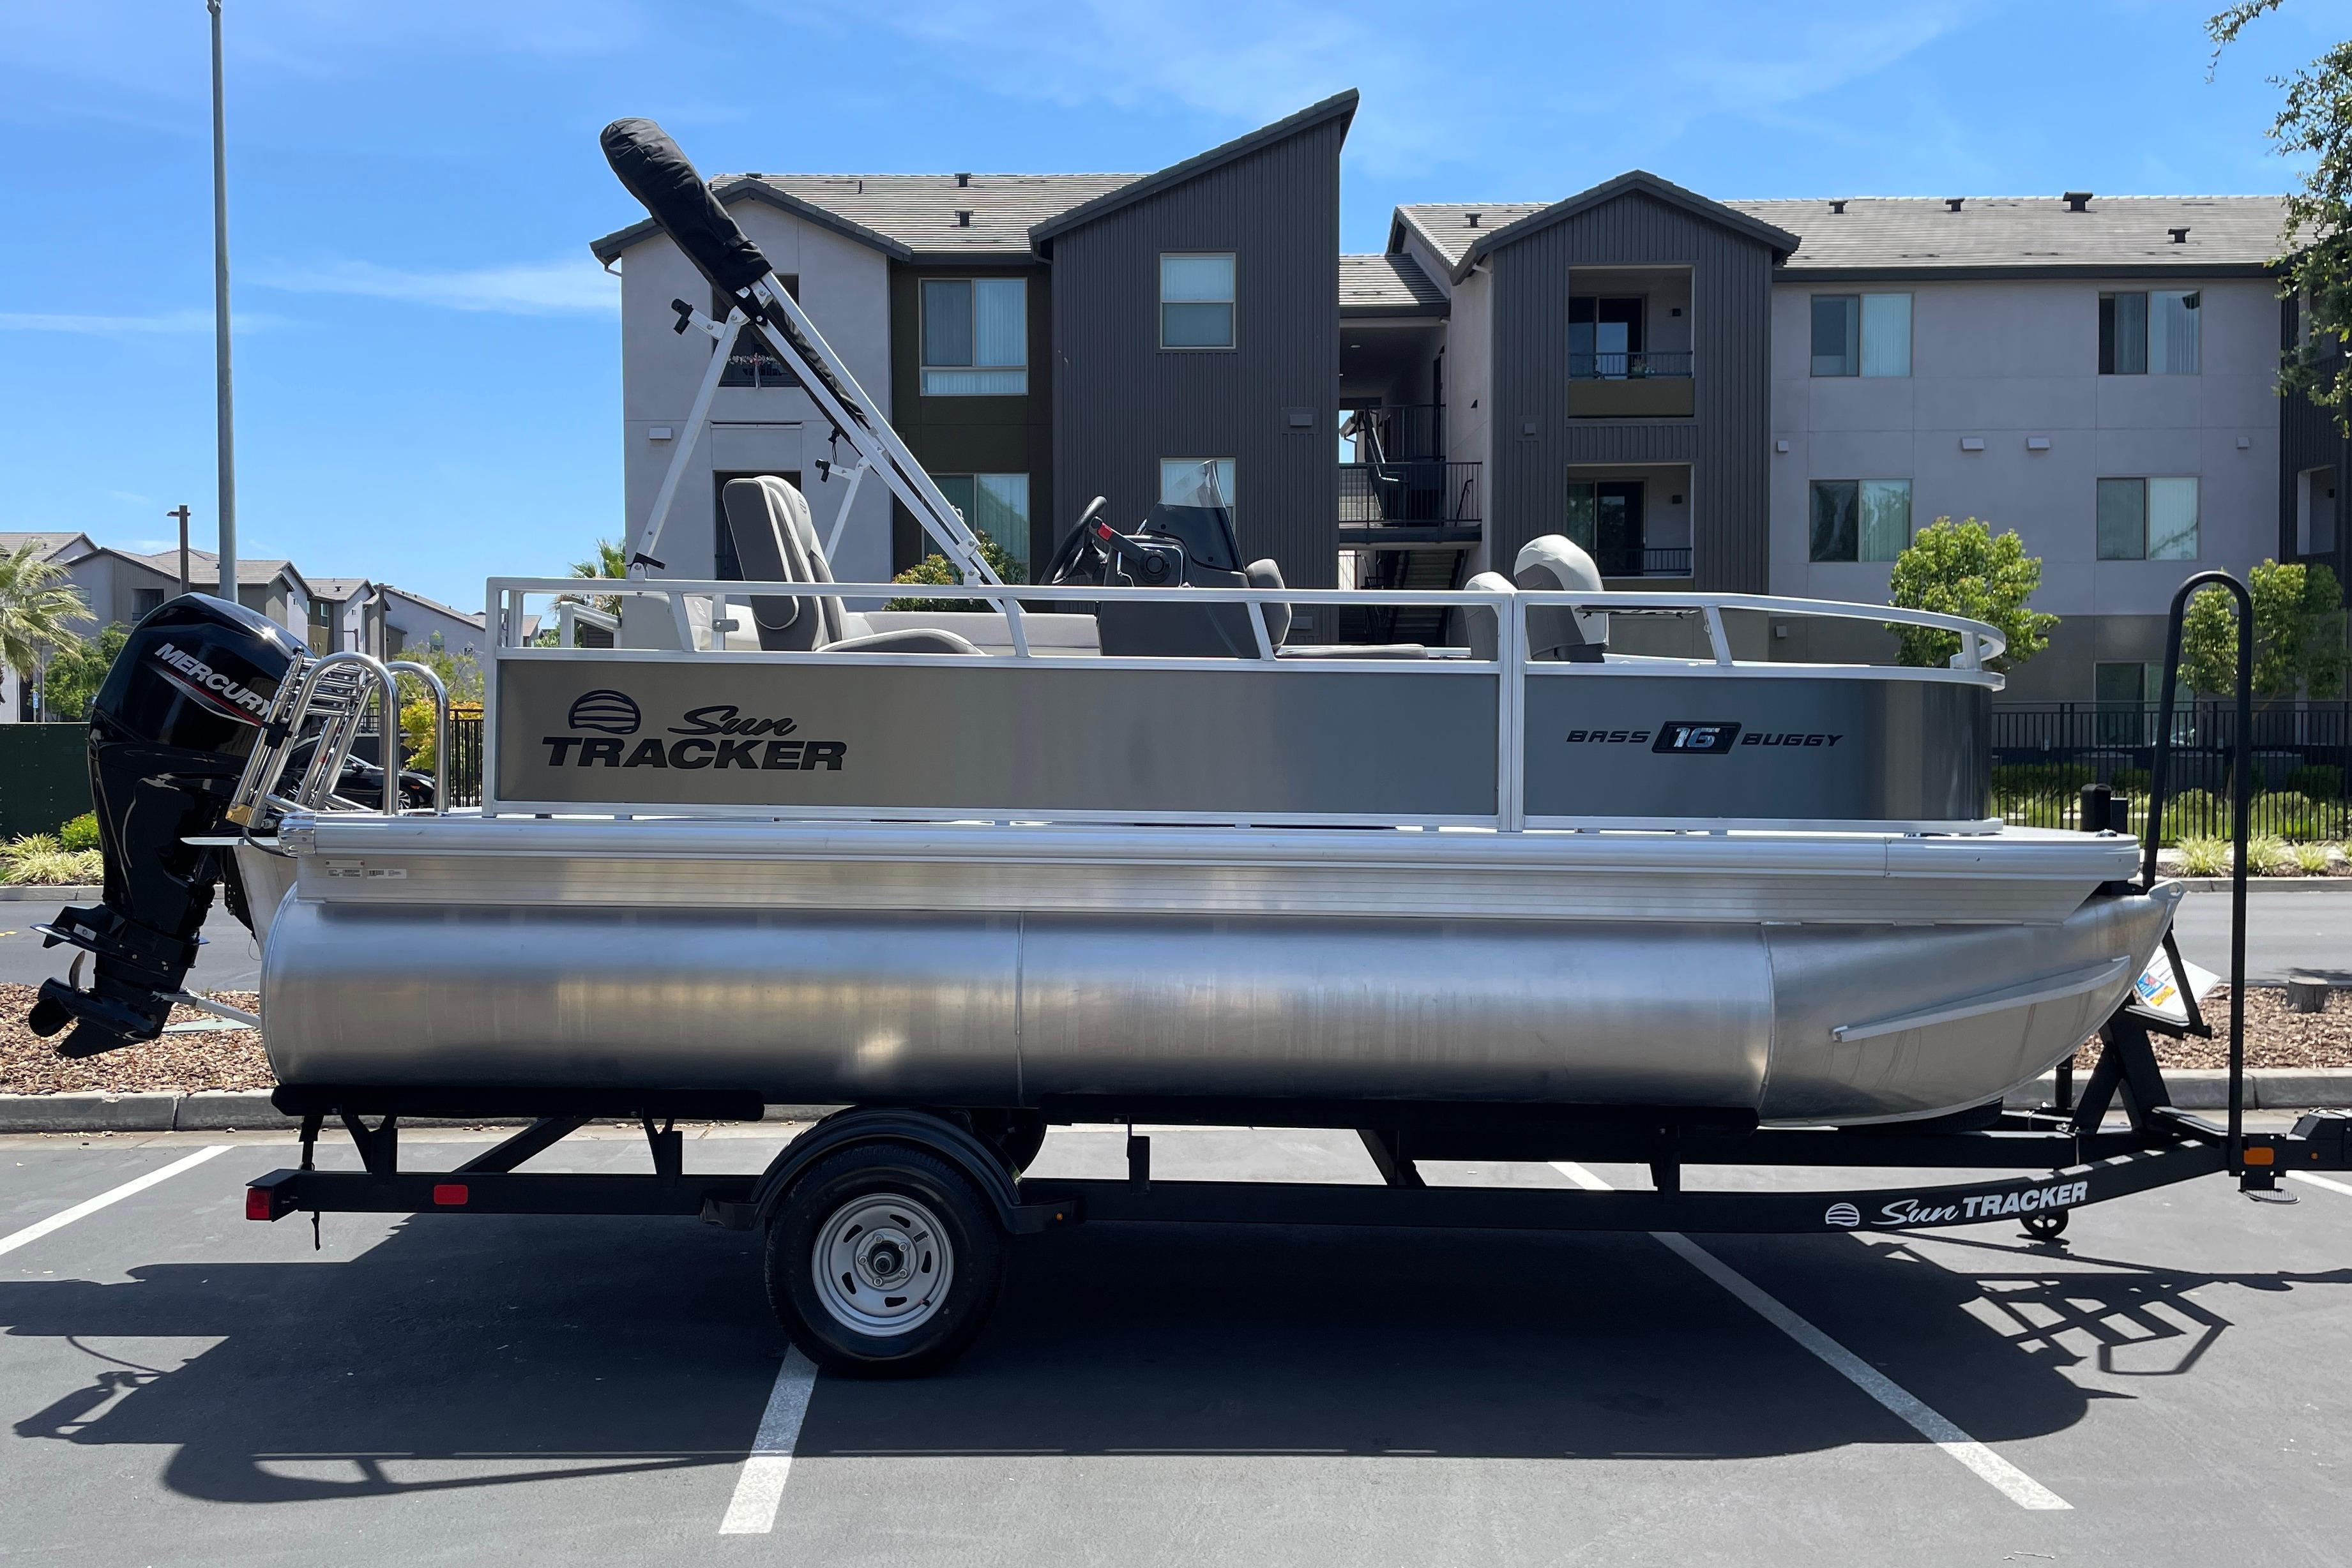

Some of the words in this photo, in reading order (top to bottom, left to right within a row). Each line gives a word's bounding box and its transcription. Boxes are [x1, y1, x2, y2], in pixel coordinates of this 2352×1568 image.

[667, 705, 798, 736] Sun
[542, 736, 847, 771] TRACKER
[1566, 730, 1651, 743] BASS
[1673, 727, 1720, 748] 16
[1741, 733, 1844, 746] BUGGY
[1870, 1198, 1960, 1225] Sun
[1962, 1181, 2088, 1217] TRACKER
